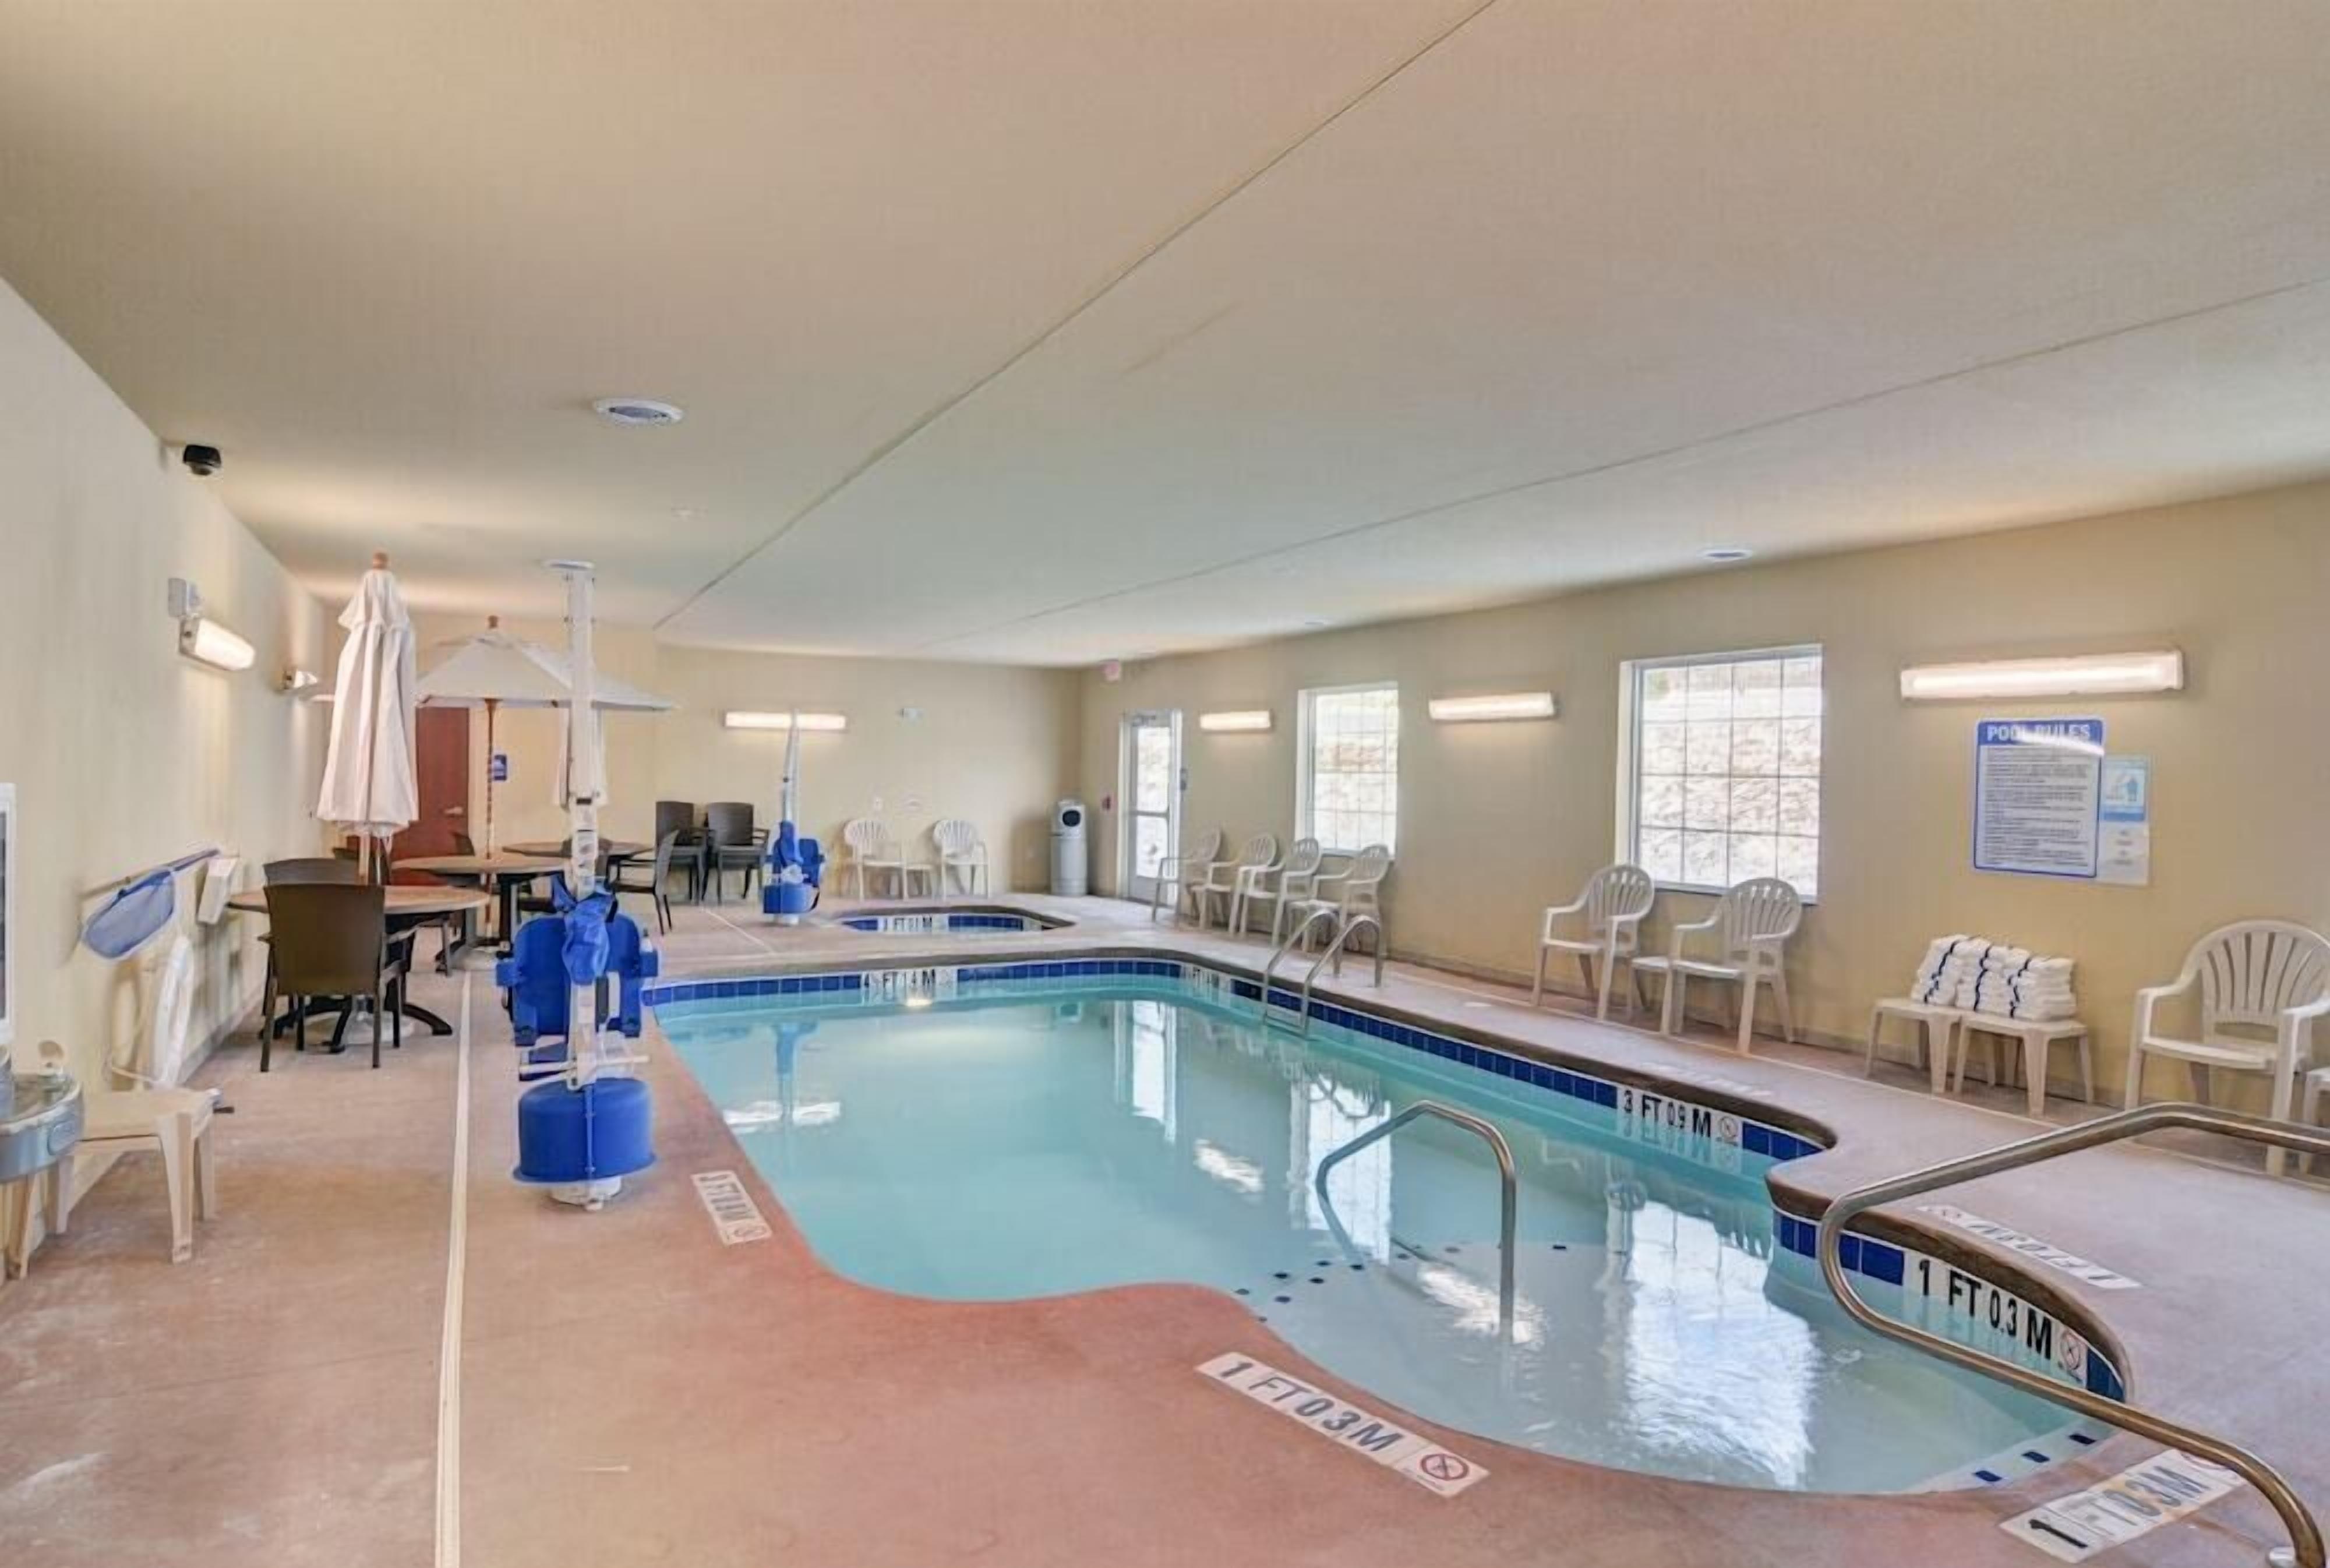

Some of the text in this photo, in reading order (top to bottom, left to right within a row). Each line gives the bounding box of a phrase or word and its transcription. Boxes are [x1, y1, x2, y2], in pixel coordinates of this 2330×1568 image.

[1642, 1094, 1662, 1122] FT
[1693, 1108, 1711, 1138] M
[1919, 1259, 1930, 1296] 1
[1948, 1270, 1982, 1317] FT
[2026, 1307, 2052, 1360] M
[1221, 1362, 1254, 1378] 1
[1248, 1376, 1314, 1402] FT
[1347, 1421, 1404, 1452] M
[2028, 1518, 2088, 1549] 1
[2137, 1464, 2212, 1499] M
